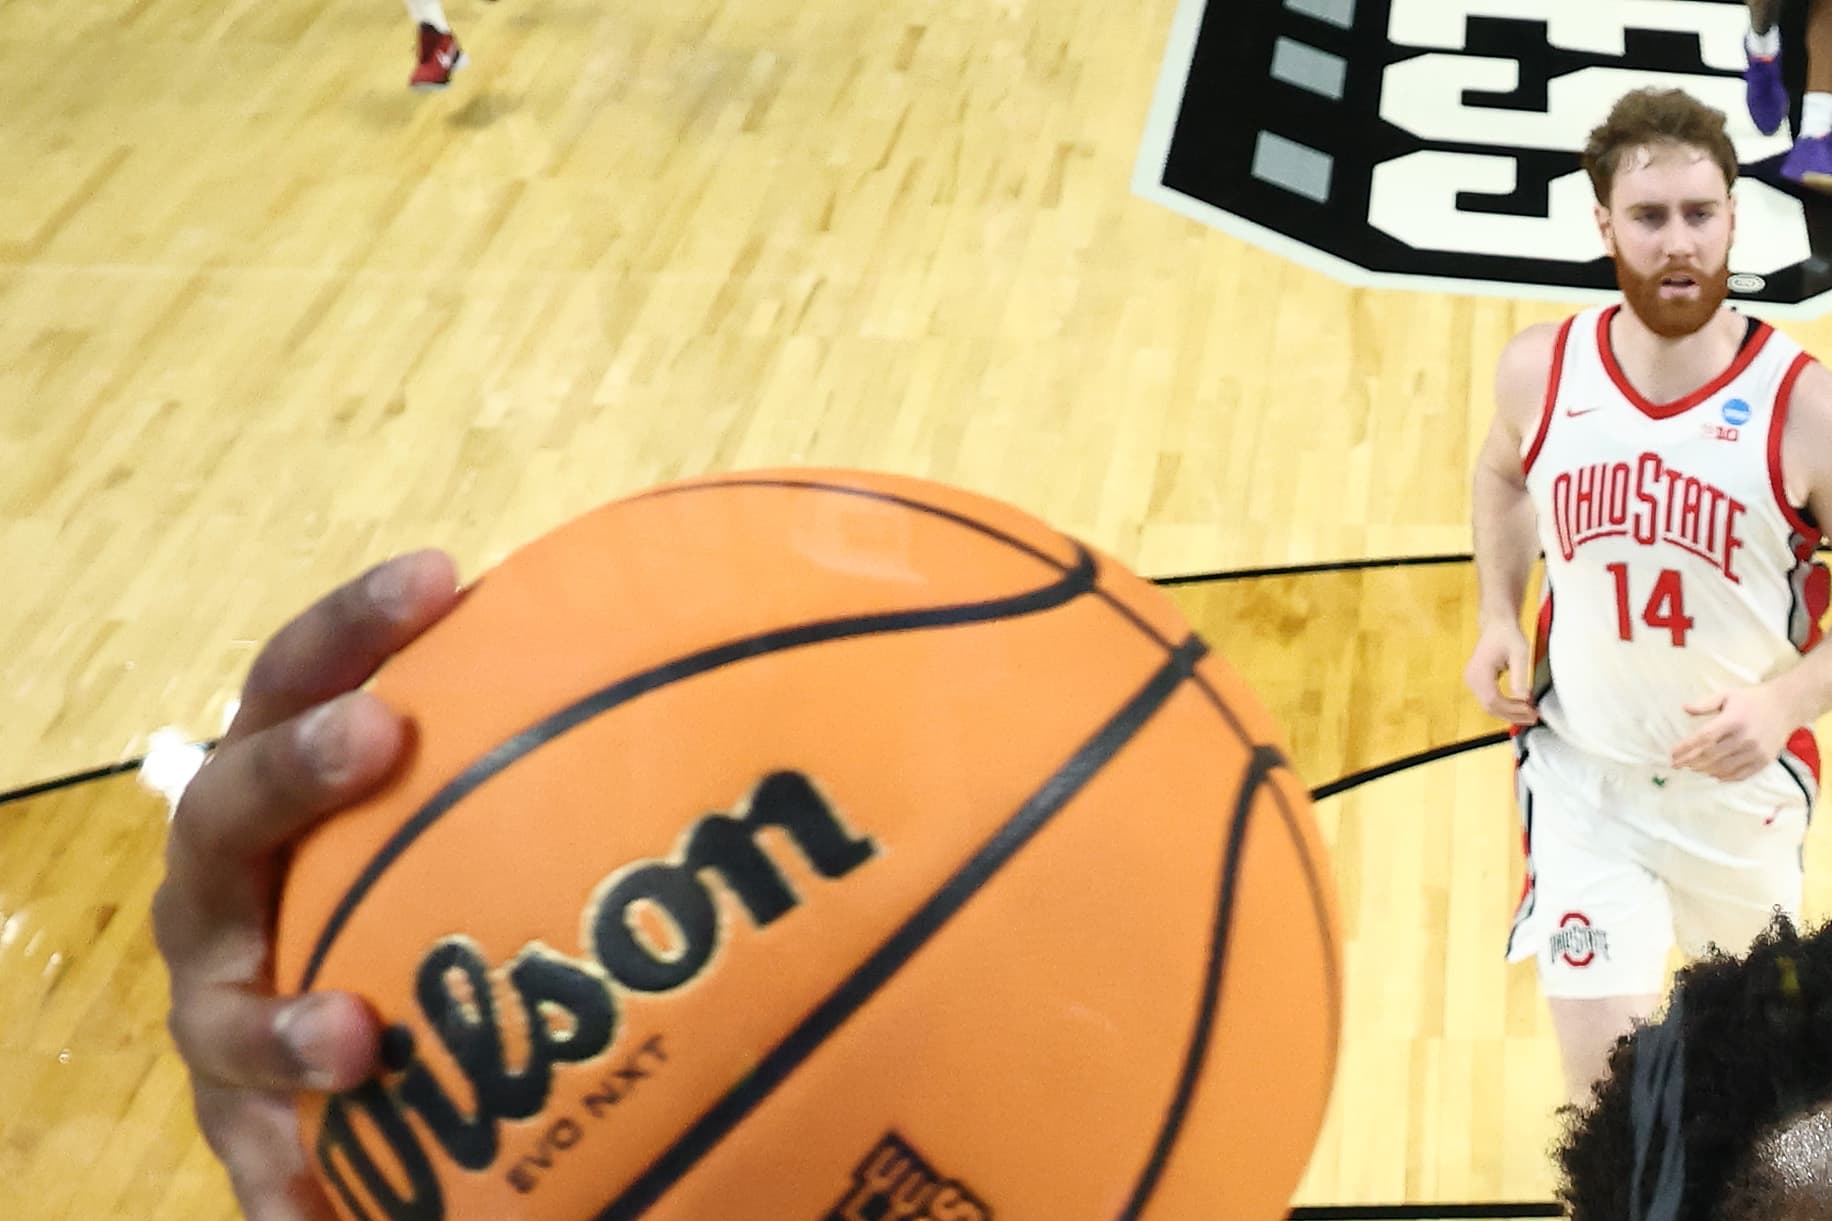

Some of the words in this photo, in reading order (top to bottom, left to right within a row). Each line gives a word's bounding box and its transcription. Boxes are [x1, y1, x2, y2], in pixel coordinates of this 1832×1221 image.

[1554, 462, 1630, 561] OHIO
[1633, 452, 1746, 583] STATE
[1606, 562, 1694, 647] 14
[506, 1117, 584, 1194] EVO
[582, 1034, 668, 1119] NXT
